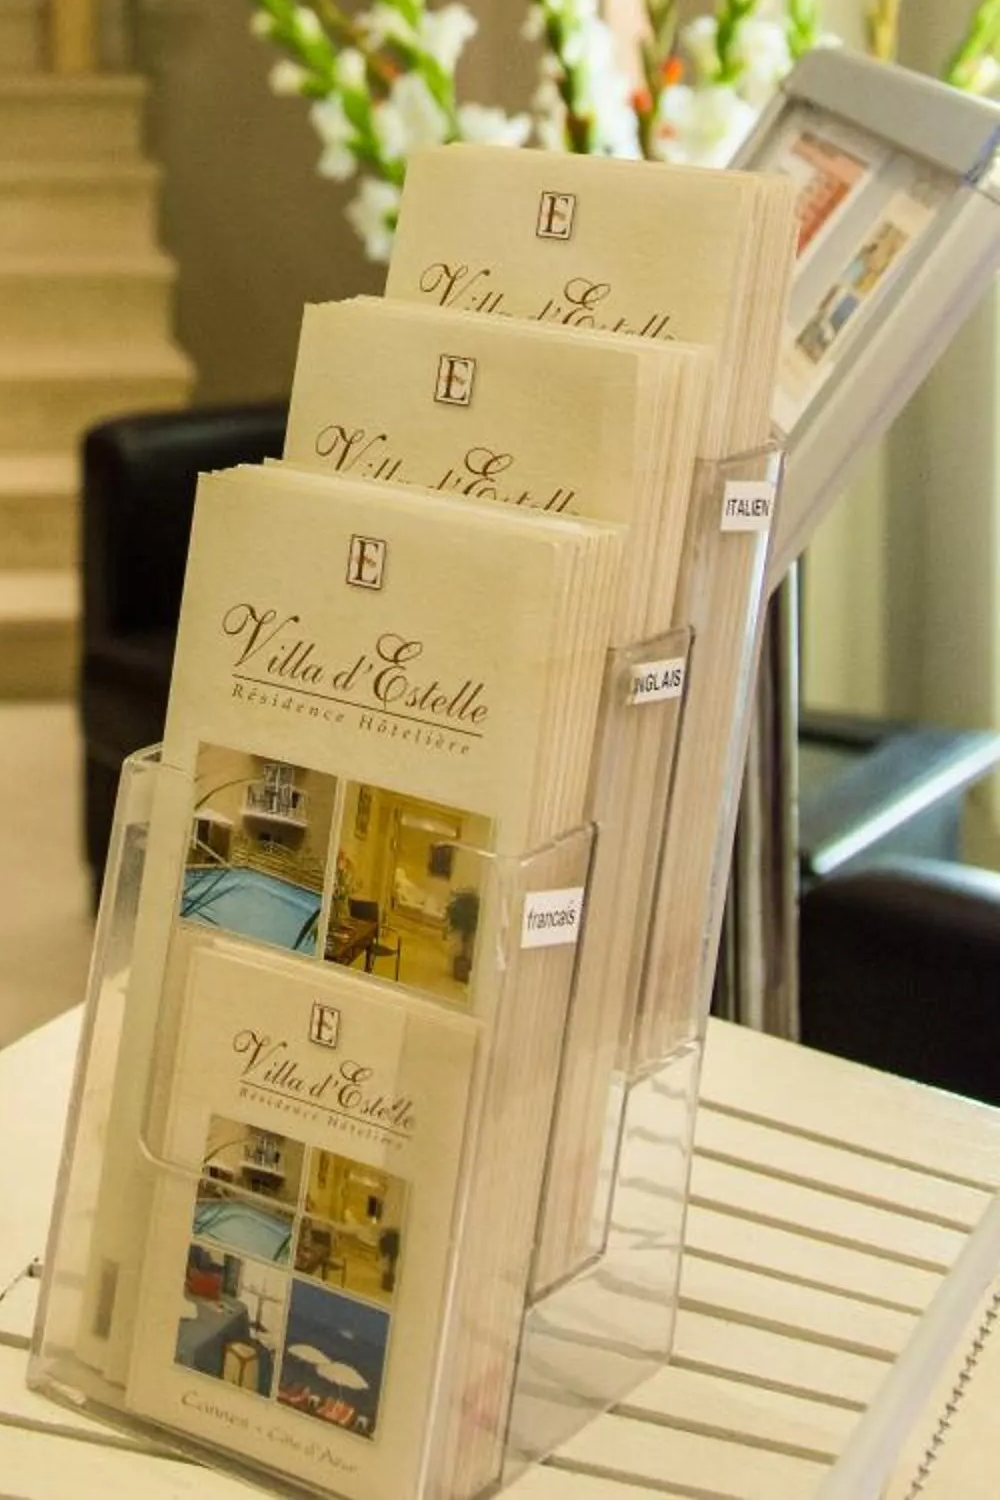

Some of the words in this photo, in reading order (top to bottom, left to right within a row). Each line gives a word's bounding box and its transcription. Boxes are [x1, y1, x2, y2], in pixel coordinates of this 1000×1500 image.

[539, 193, 573, 238] E
[419, 263, 513, 317] Vll
[437, 357, 474, 403] E
[315, 425, 410, 484] Vll
[725, 498, 770, 517] ITALIEN
[350, 536, 383, 588] E
[222, 603, 325, 683] Villa
[333, 633, 490, 725] d'Estelle
[633, 669, 681, 695] NGLAIS
[231, 683, 346, 723] Résidence
[358, 713, 471, 756] Hôtelière
[312, 1005, 338, 1047] E
[232, 1029, 302, 1090] Villa
[309, 1060, 414, 1129] d'Estelle
